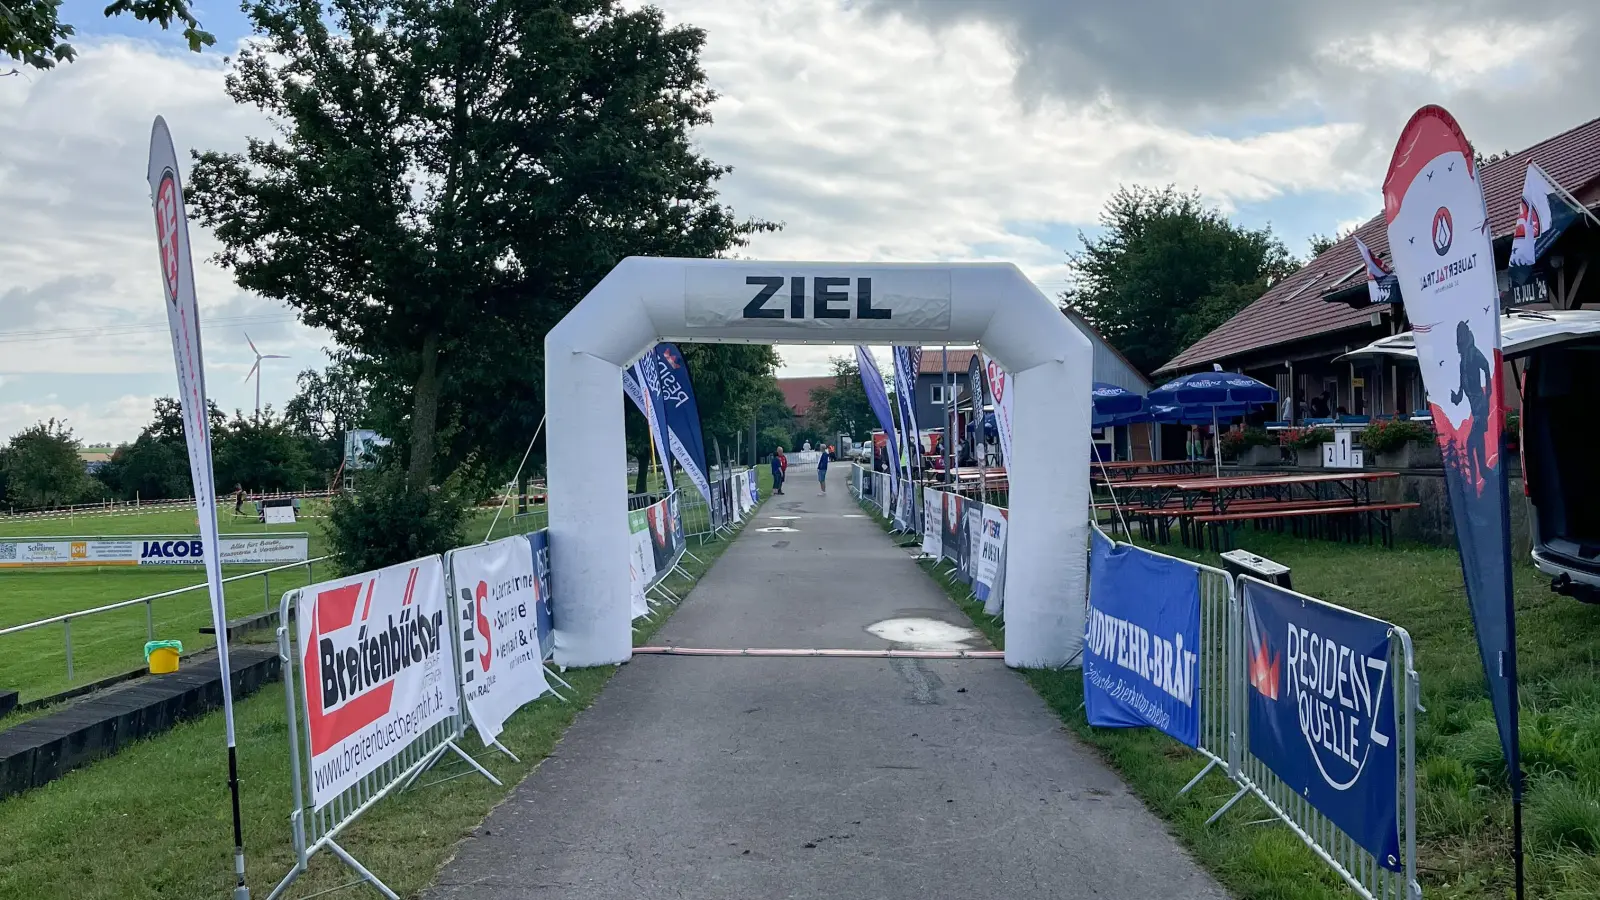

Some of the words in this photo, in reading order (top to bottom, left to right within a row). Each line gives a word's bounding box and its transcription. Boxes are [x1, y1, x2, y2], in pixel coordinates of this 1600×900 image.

[743, 276, 892, 319] ZIEL
[1521, 283, 1535, 302] JULI
[1328, 447, 1333, 462] 2
[1341, 438, 1346, 460] 1
[141, 541, 203, 558] JACOB
[320, 604, 443, 709] Breitenbücher
[1287, 622, 1390, 747] RESIDENZ
[1299, 690, 1360, 769] QUELLE
